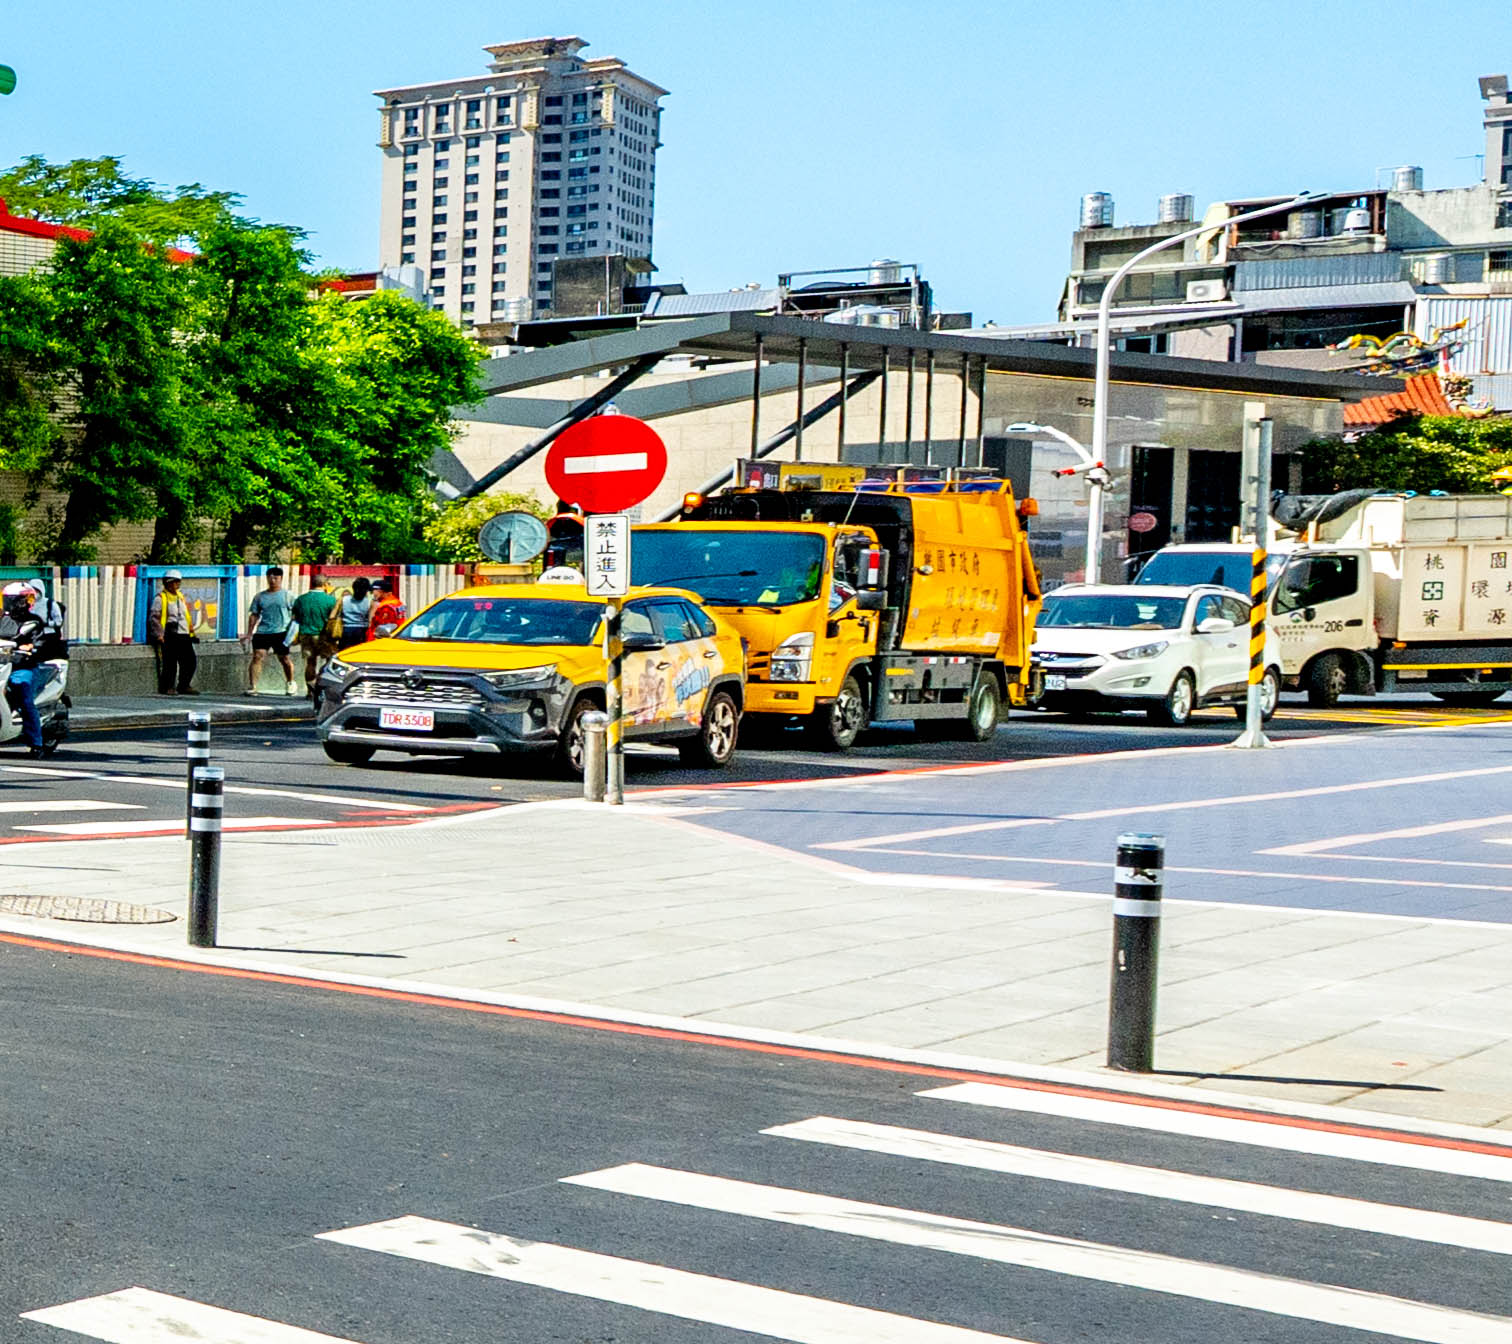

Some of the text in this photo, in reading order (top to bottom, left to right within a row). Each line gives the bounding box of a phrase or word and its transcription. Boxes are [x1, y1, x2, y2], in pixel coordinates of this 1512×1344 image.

[595, 522, 617, 590] 禁止進入
[1424, 551, 1507, 570] 桃園
[1324, 620, 1343, 632] 206
[1422, 608, 1507, 627] 資源
